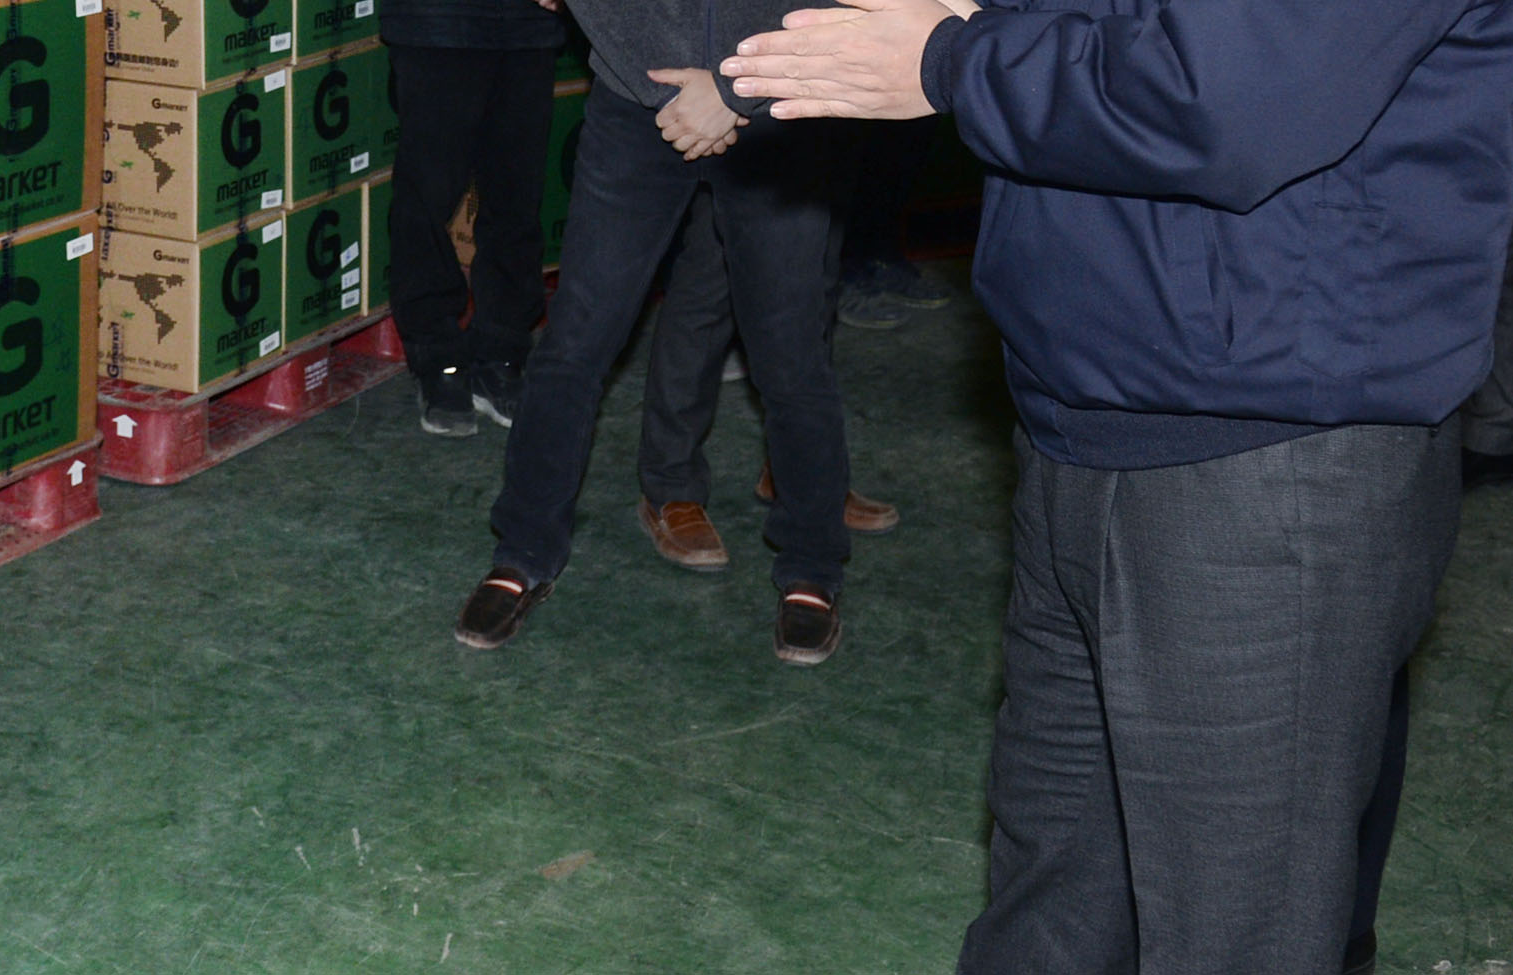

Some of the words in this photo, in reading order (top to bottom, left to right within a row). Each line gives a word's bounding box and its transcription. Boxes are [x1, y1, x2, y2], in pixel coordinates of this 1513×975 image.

[315, 6, 356, 28] marke
[152, 98, 188, 111] Gmarket
[314, 70, 350, 140] G
[221, 93, 261, 167] G
[138, 206, 151, 215] the
[153, 208, 178, 220] World!
[153, 249, 189, 264] Gmarket
[307, 210, 340, 280] G
[222, 243, 260, 317] G
[303, 285, 341, 313] marke
